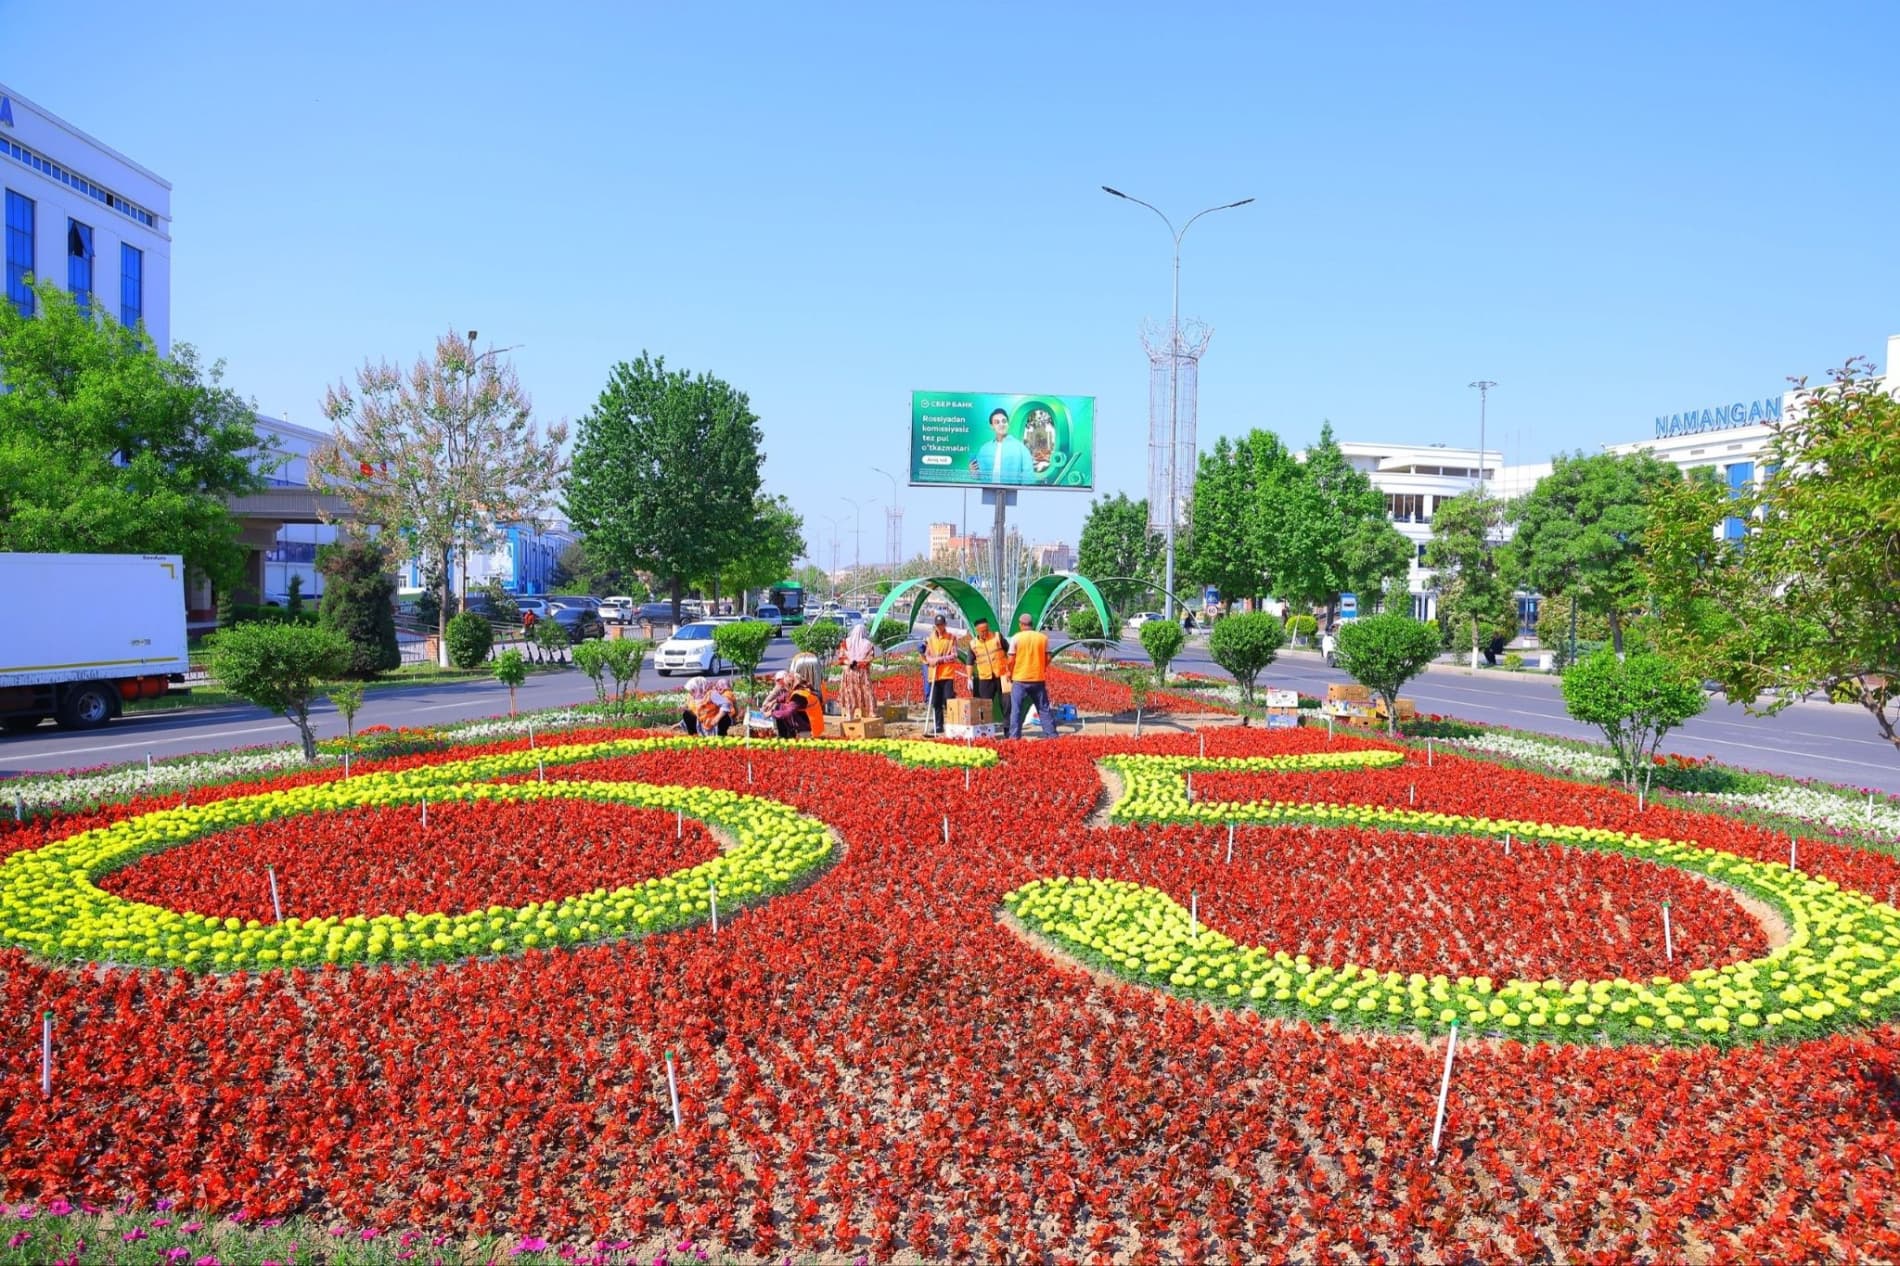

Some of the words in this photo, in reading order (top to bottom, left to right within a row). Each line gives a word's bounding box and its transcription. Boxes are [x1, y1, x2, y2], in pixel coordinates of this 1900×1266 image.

[922, 415, 966, 424] Rossiyadan
[1655, 397, 1782, 435] NAMANGAN
[922, 424, 970, 433] komissiyasiz
[922, 434, 935, 442] tez
[936, 434, 949, 443] pul
